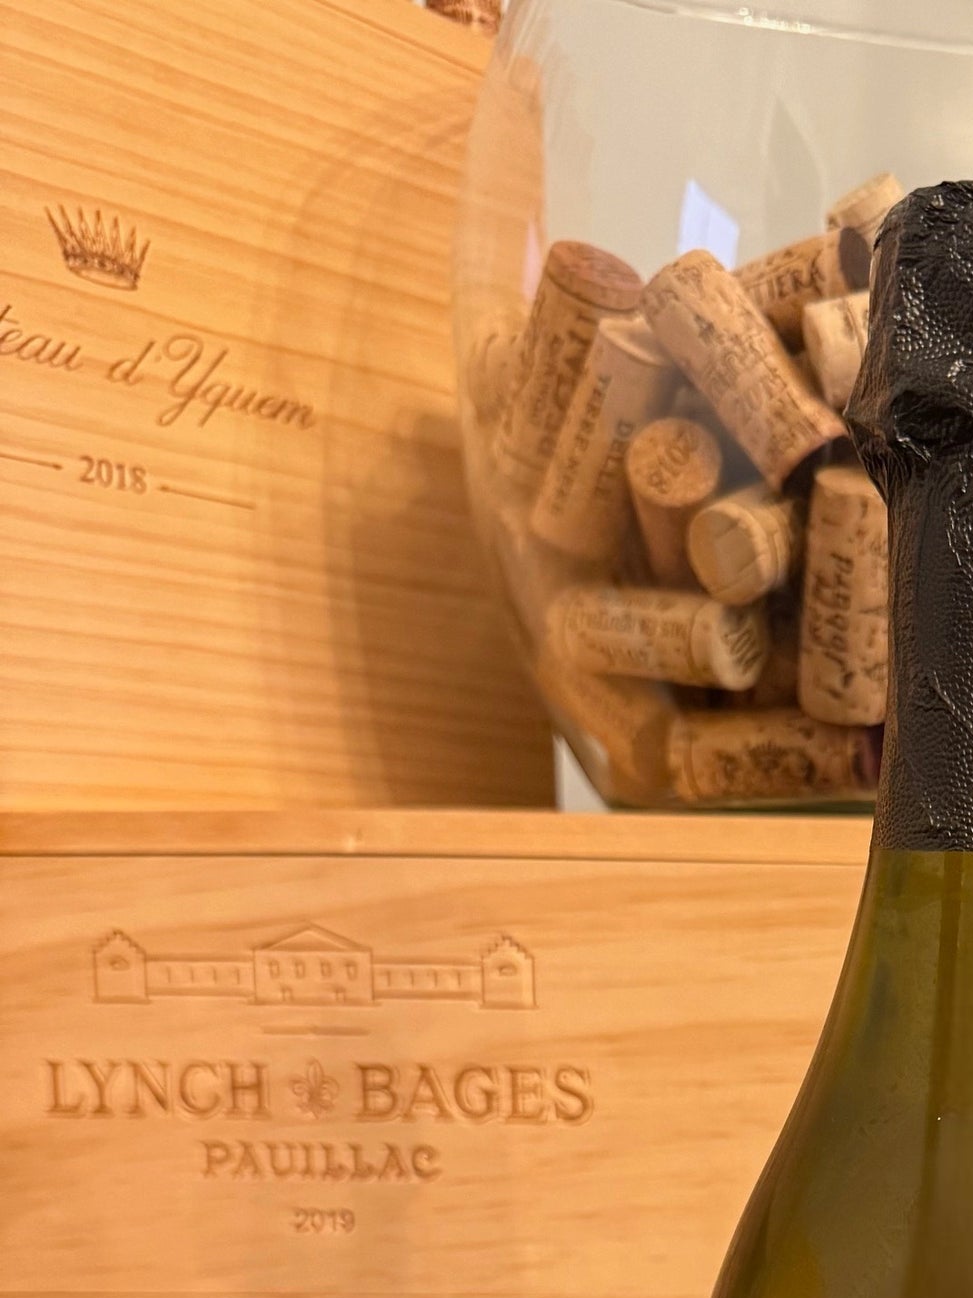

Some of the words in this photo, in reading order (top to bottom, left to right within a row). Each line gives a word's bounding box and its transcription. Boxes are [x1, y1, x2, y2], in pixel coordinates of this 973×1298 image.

[105, 332, 316, 430] d'Yquem
[78, 454, 148, 496] 2018
[44, 1057, 272, 1121] LYNCH
[353, 1060, 597, 1127] BAGES
[202, 1139, 443, 1183] PAUILLAC
[292, 1206, 357, 1234] 2019
